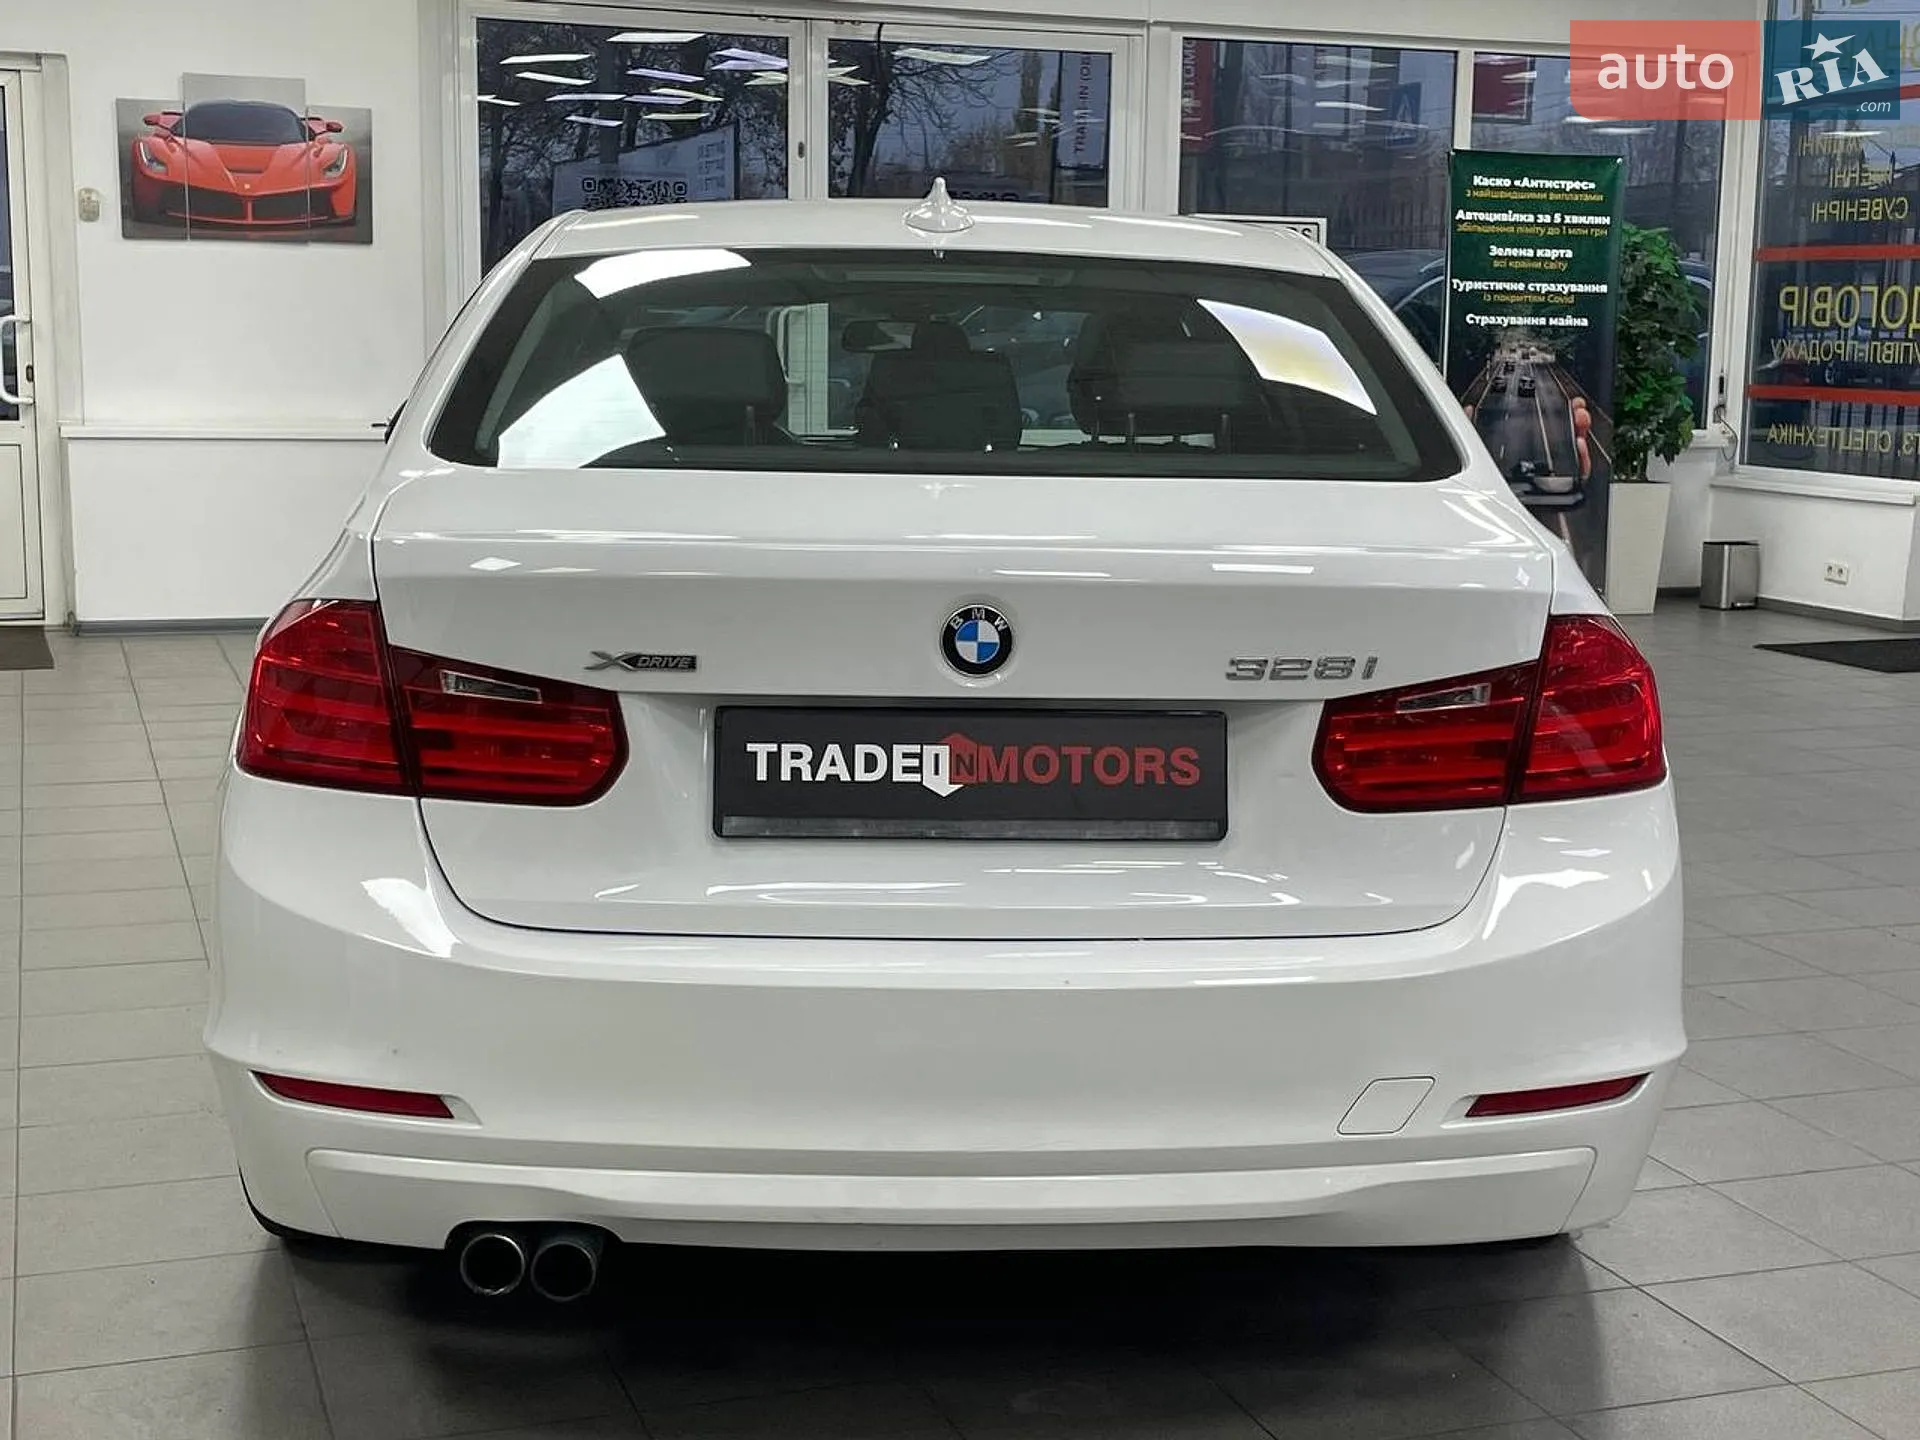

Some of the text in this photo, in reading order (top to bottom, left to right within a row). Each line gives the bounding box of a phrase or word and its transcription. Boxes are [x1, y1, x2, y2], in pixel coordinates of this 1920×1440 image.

[1473, 175, 1596, 191] Каско «Антистрес»
[1455, 209, 1611, 225] Автоцивілка за 5 хвилин
[1489, 245, 1573, 260] Зелена карта
[1451, 279, 1608, 294] Туристичне страхування
[1466, 313, 1588, 327] Страхування майна
[949, 606, 1008, 632] BMW
[746, 742, 921, 783] TRADE
[978, 746, 1201, 785] MOTORS
